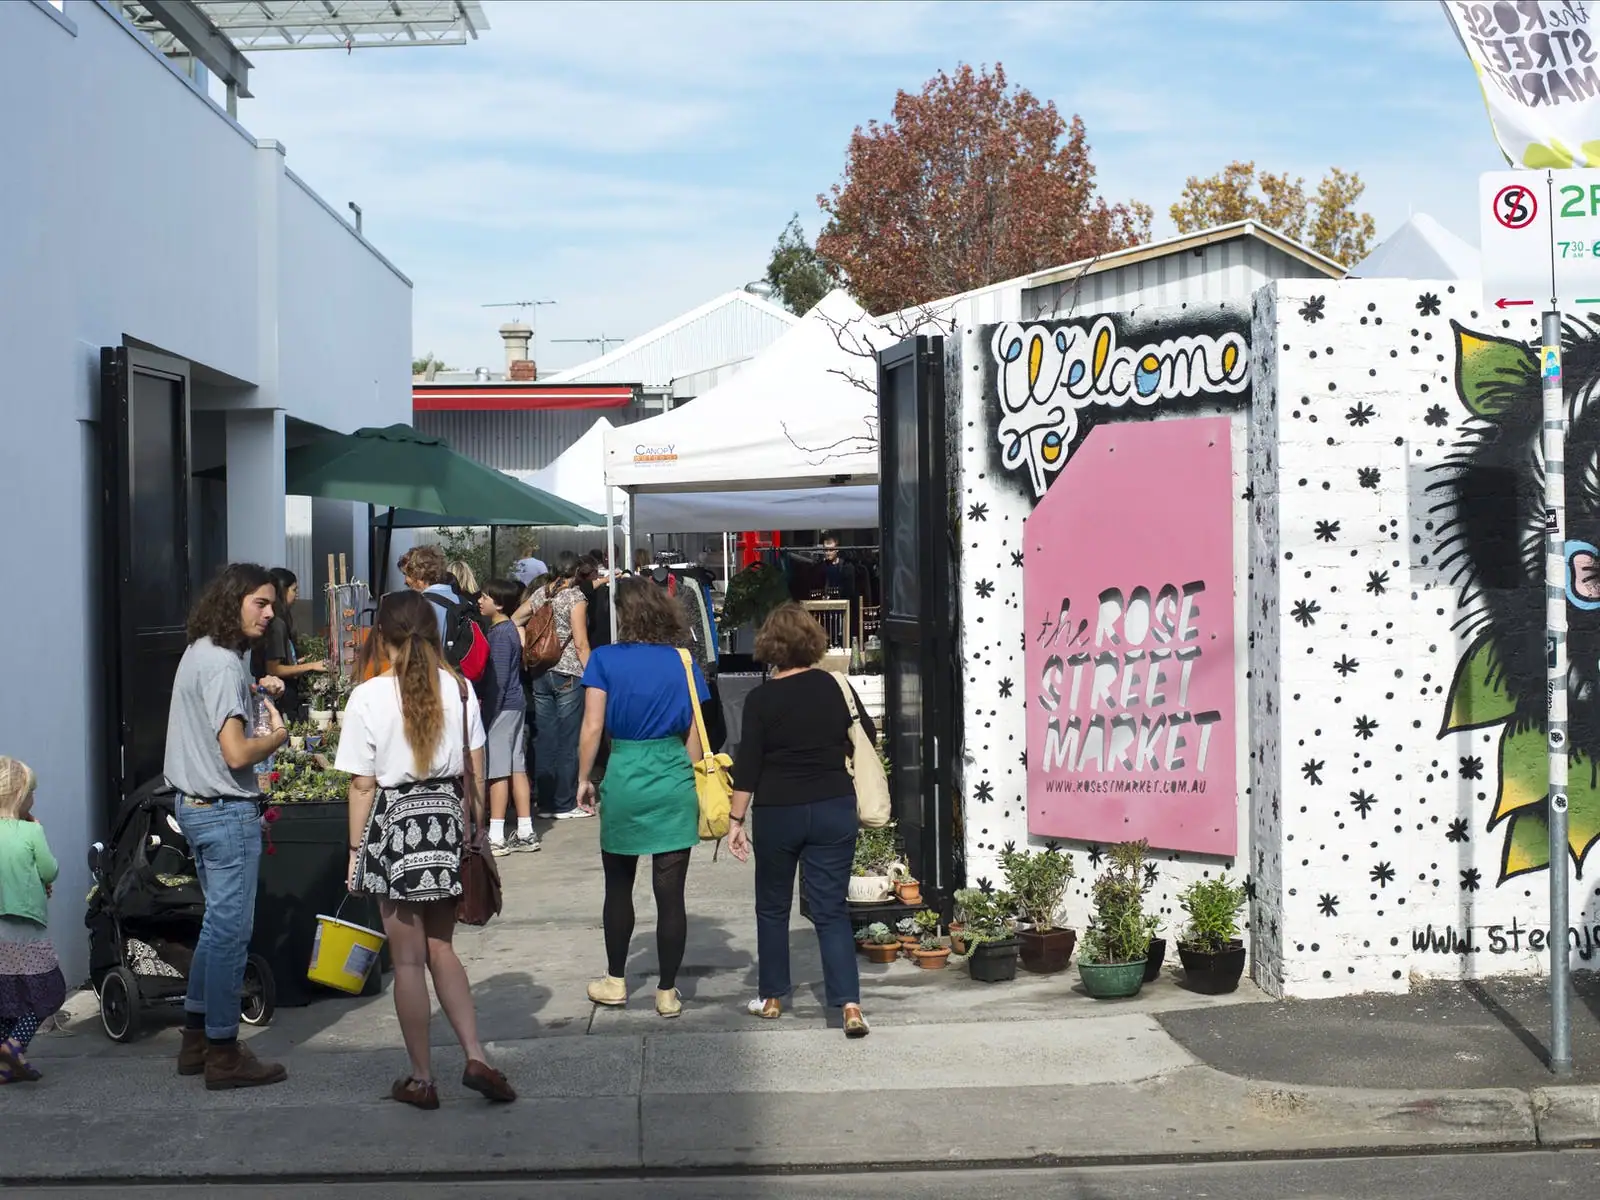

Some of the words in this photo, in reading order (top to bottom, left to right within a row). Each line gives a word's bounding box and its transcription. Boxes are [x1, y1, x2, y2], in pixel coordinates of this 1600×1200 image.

[998, 323, 1250, 414] Welcome
[1037, 597, 1090, 648] the
[1095, 580, 1206, 647] ROSE
[1038, 646, 1202, 711] STREET
[1043, 711, 1221, 773] MARKET
[1045, 779, 1207, 794] WWW.ROSESTMARKET.COM.AU
